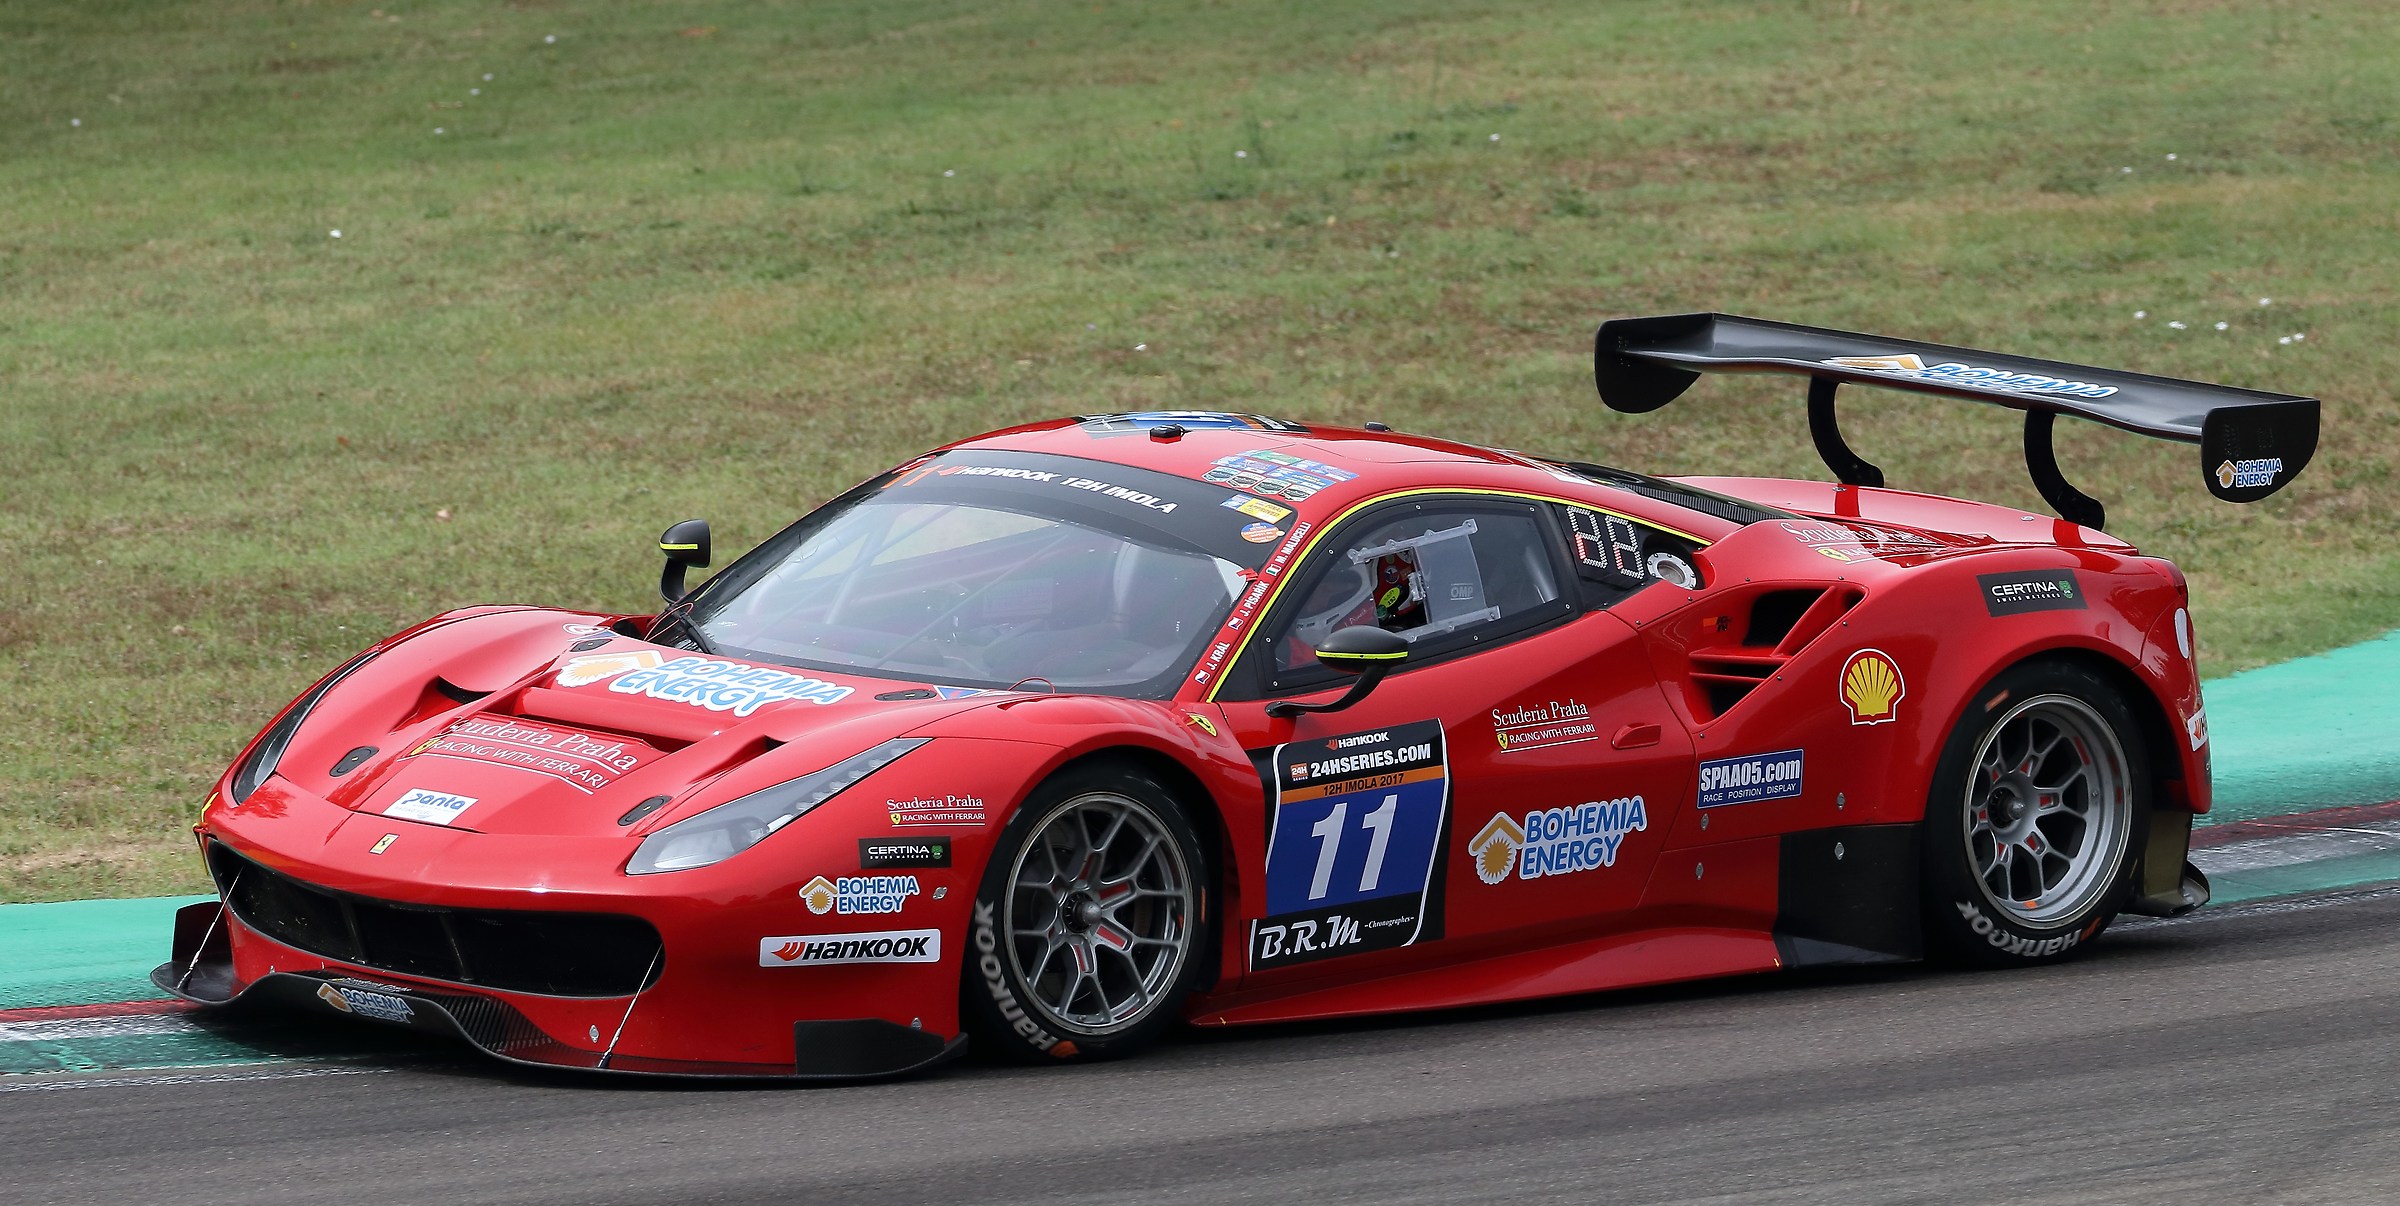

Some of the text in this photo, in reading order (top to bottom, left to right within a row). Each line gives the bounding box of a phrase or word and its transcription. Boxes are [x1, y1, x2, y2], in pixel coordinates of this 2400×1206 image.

[1925, 363, 2114, 397] BOHEMIA
[2236, 460, 2282, 474] BOHEMIA
[2236, 473, 2274, 487] ENERGY
[1060, 476, 1109, 494] 12H
[1101, 484, 1179, 515] IMOLA
[1280, 522, 1312, 556] MALUCELLI
[1450, 585, 1474, 598] OMP
[1991, 581, 2059, 597] CERTINA
[1240, 609, 1251, 617] J.
[1207, 641, 1231, 671] J. KRÁL
[615, 671, 785, 713] ENERGY
[655, 657, 850, 704] BOHEMIA
[1492, 698, 1589, 727] Scuderia Praha
[1509, 723, 1596, 744] RACING WITH FERRARI
[552, 732, 639, 771] Praha
[1310, 743, 1431, 778] 24HSERIES.COM
[432, 739, 610, 790] RACING WITH FERRARI
[1291, 766, 1307, 776] 24H
[1323, 773, 1404, 797] 12H IMOLA 2017
[1703, 782, 1797, 803] RACE POSITION DISPLAY
[401, 792, 466, 811] panta
[886, 794, 983, 811] Scuderia Praha
[902, 812, 985, 822] RACING WITH FERRARI
[1526, 799, 1645, 844] BOHEMIA
[867, 845, 930, 855] CERTINA
[1308, 794, 1398, 900] 11
[1522, 833, 1621, 876] ENERGY
[838, 876, 918, 896] BOHEMIA
[838, 895, 905, 912] ENERGY
[342, 989, 414, 1014] BOHEMIA
